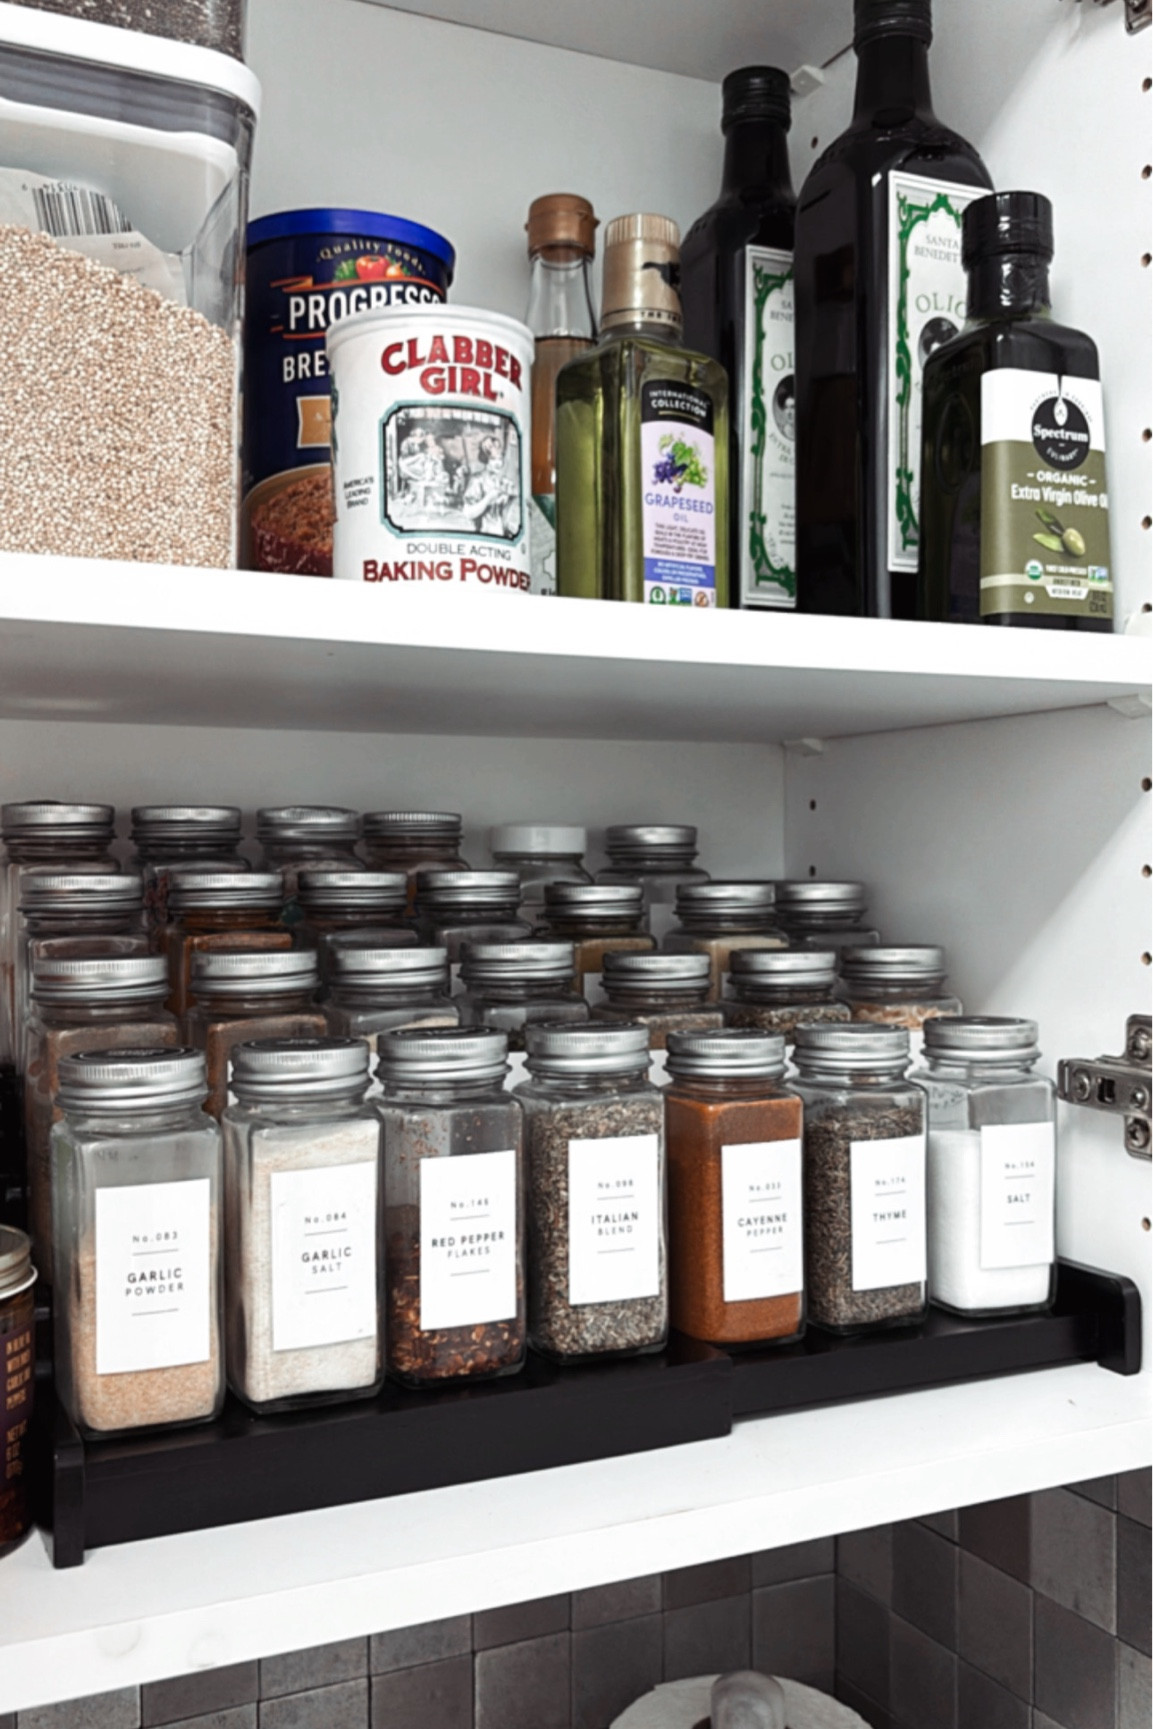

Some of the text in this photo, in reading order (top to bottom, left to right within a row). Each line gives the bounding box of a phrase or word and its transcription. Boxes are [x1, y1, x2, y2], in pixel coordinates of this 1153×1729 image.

[320, 239, 380, 260] Quality
[926, 235, 959, 250] SANTA
[914, 245, 961, 263] BENEDET
[289, 284, 439, 331] PROGRESS
[283, 350, 332, 383] BRE
[381, 335, 523, 391] CLABBER
[420, 366, 498, 402] GIRL
[649, 390, 708, 409] INTERNATIONAL
[651, 399, 707, 417] COLLECTION
[1033, 424, 1089, 443] Spectrum
[1036, 470, 1089, 486] ORGANIC
[1011, 483, 1040, 500] Extra
[1042, 487, 1073, 506] Virgin
[1074, 490, 1098, 506] Olive
[645, 493, 714, 515] GRAPESEED
[673, 513, 688, 523] OIL
[407, 543, 465, 555] DOUBLE
[470, 546, 511, 561] ACTING
[363, 559, 453, 583] BAKING
[1007, 1193, 1030, 1204] SALT
[591, 1211, 639, 1224] ITALIAN
[737, 1213, 787, 1228] CAYENNE
[872, 1209, 907, 1222] THYME
[598, 1224, 633, 1236] BLEND
[747, 1226, 783, 1237] PEPPER
[431, 1231, 504, 1248] RED PEPPER
[301, 1246, 352, 1263] GARLIC
[447, 1245, 490, 1259] FLAKES
[127, 1267, 182, 1284] GARLIC
[312, 1261, 342, 1275] SALT
[125, 1281, 184, 1297] POWDER
